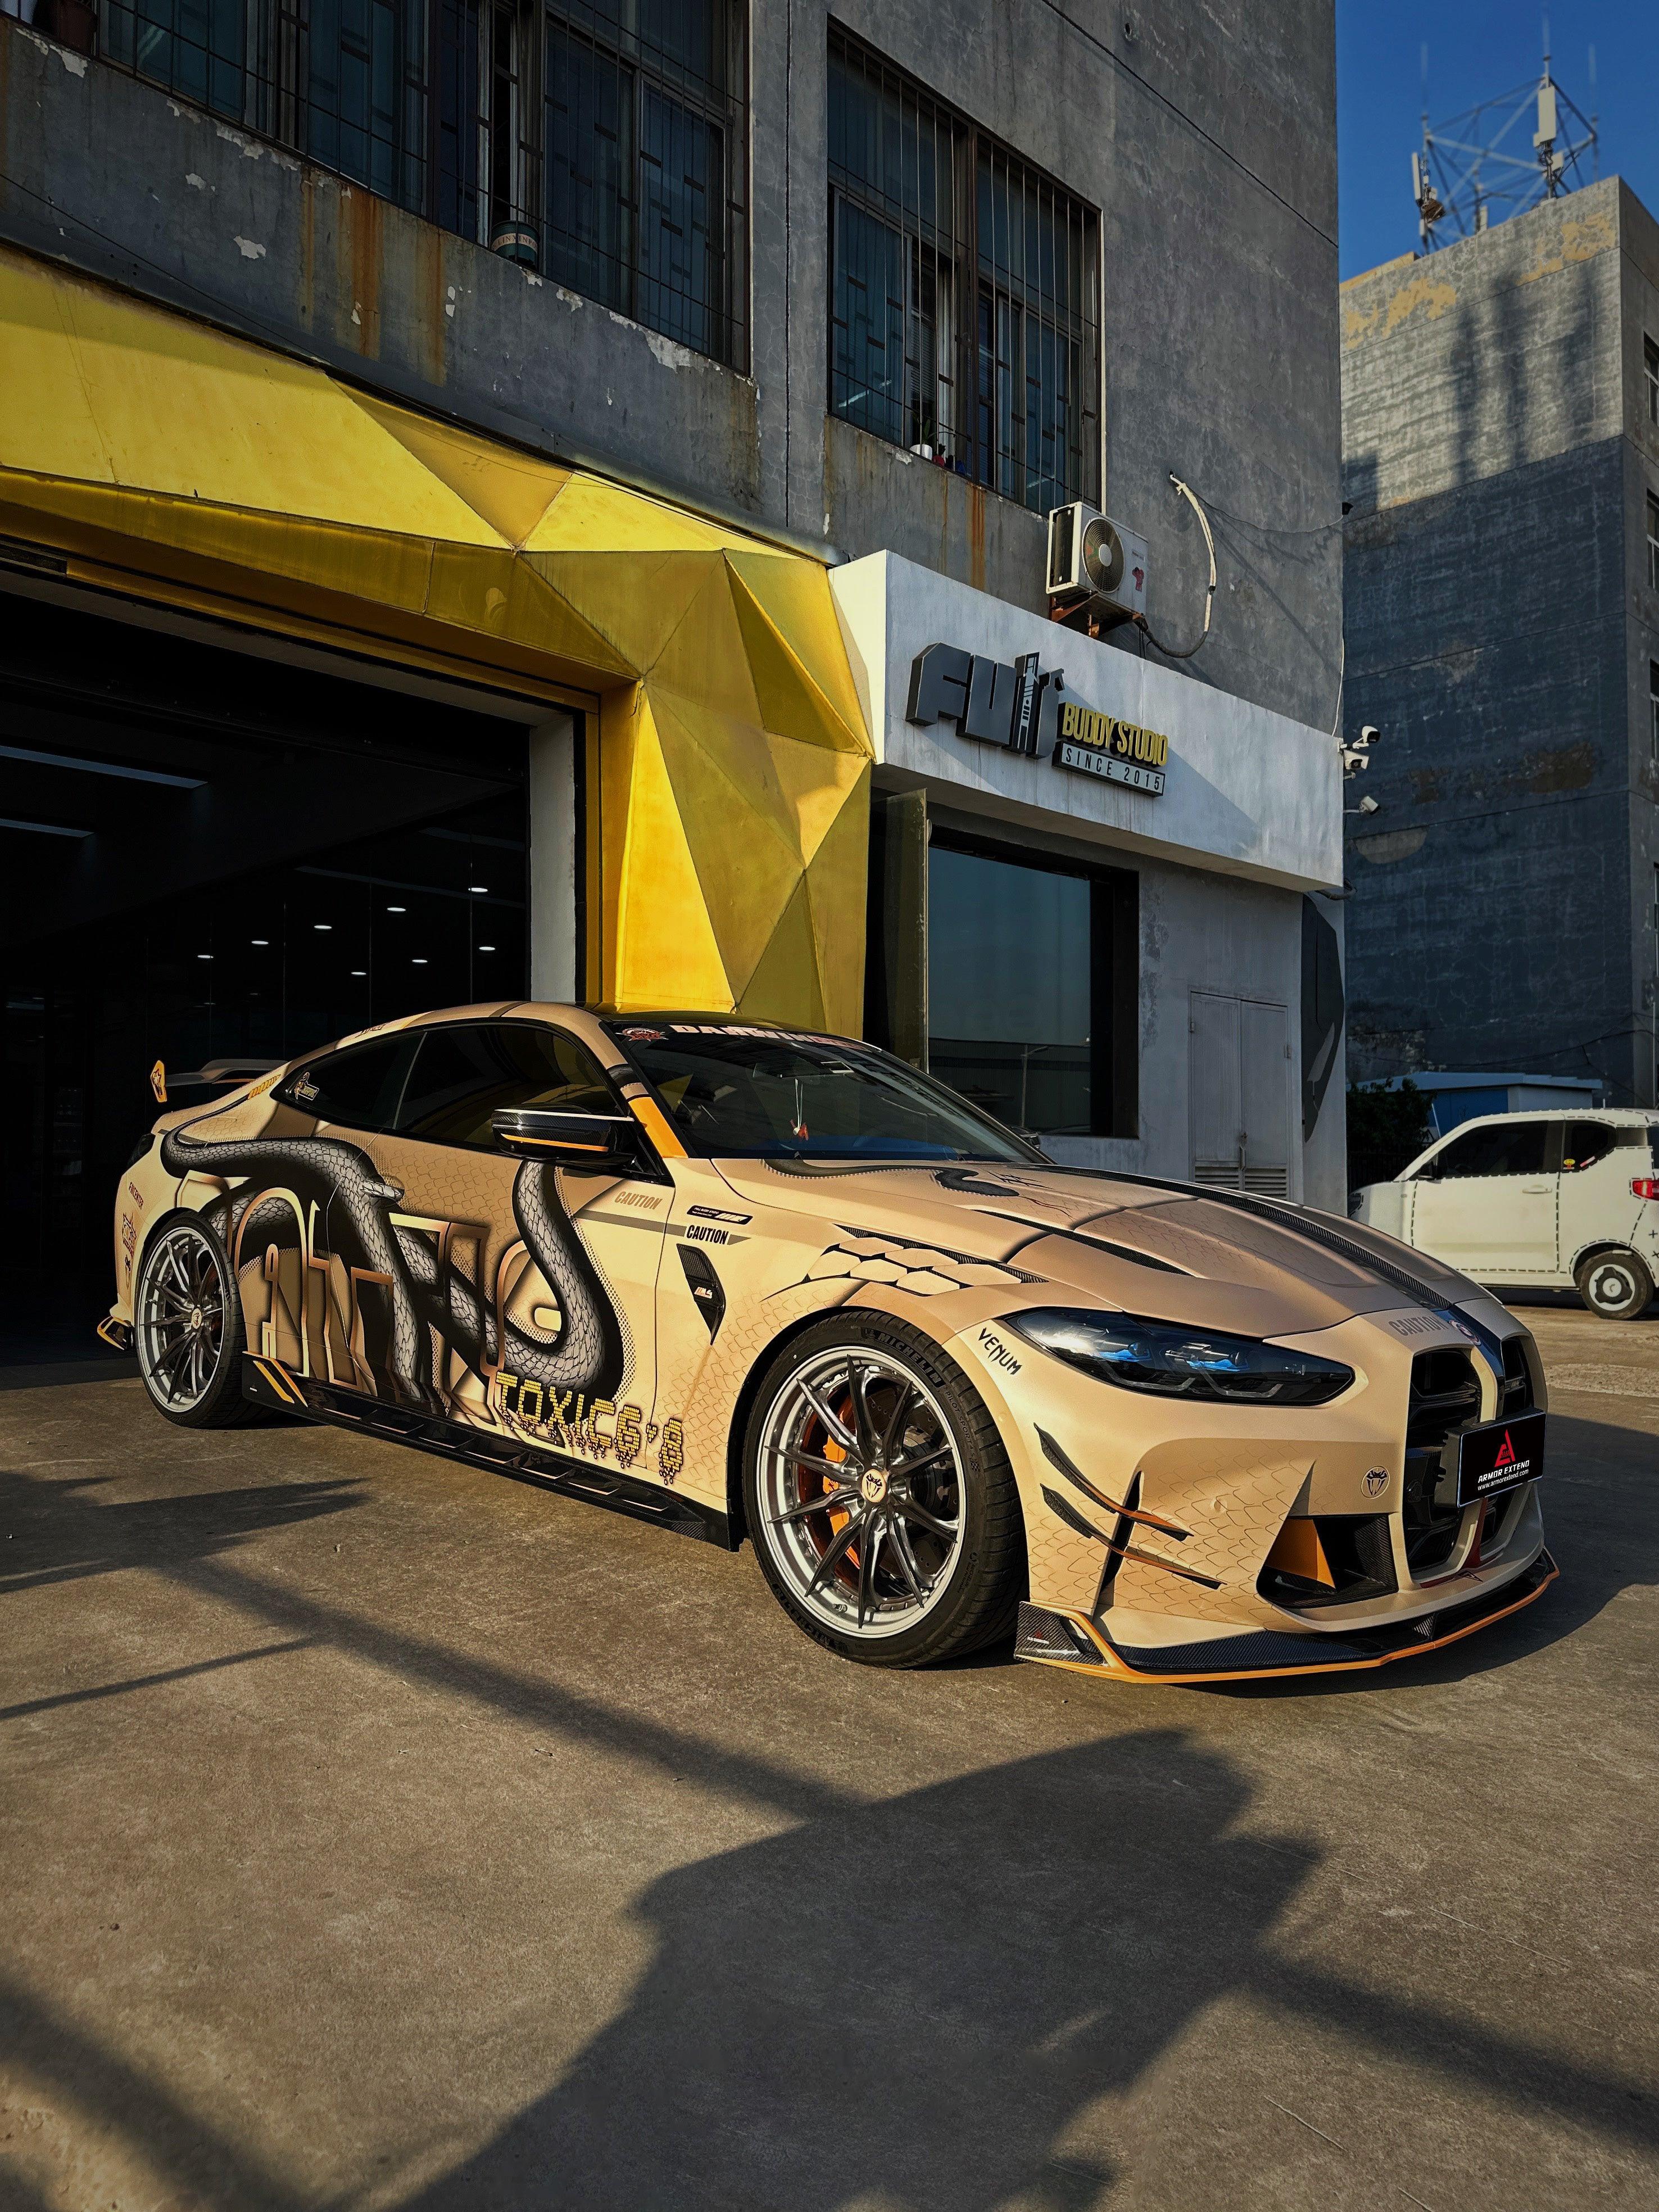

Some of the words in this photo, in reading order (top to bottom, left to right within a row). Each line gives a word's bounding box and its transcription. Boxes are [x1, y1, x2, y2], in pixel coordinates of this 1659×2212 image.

[1061, 702, 1116, 749] BUDDY
[1117, 720, 1168, 767] STUDIO
[1066, 748, 1113, 776] SINCE
[1123, 767, 1161, 791] 2015
[614, 1191, 663, 1210] CAUTION
[686, 1225, 729, 1245] CAUTION
[1388, 1316, 1449, 1336] CAUTION
[877, 1332, 942, 1384] MICHELIN
[978, 1327, 1023, 1375] VENUM
[945, 1391, 960, 1412] PILOT
[958, 1416, 973, 1444] SPORT
[1477, 1468, 1503, 1484] ARMOR
[1504, 1459, 1530, 1475] EXTEND
[1477, 1468, 1529, 1491] www.armorextend.com
